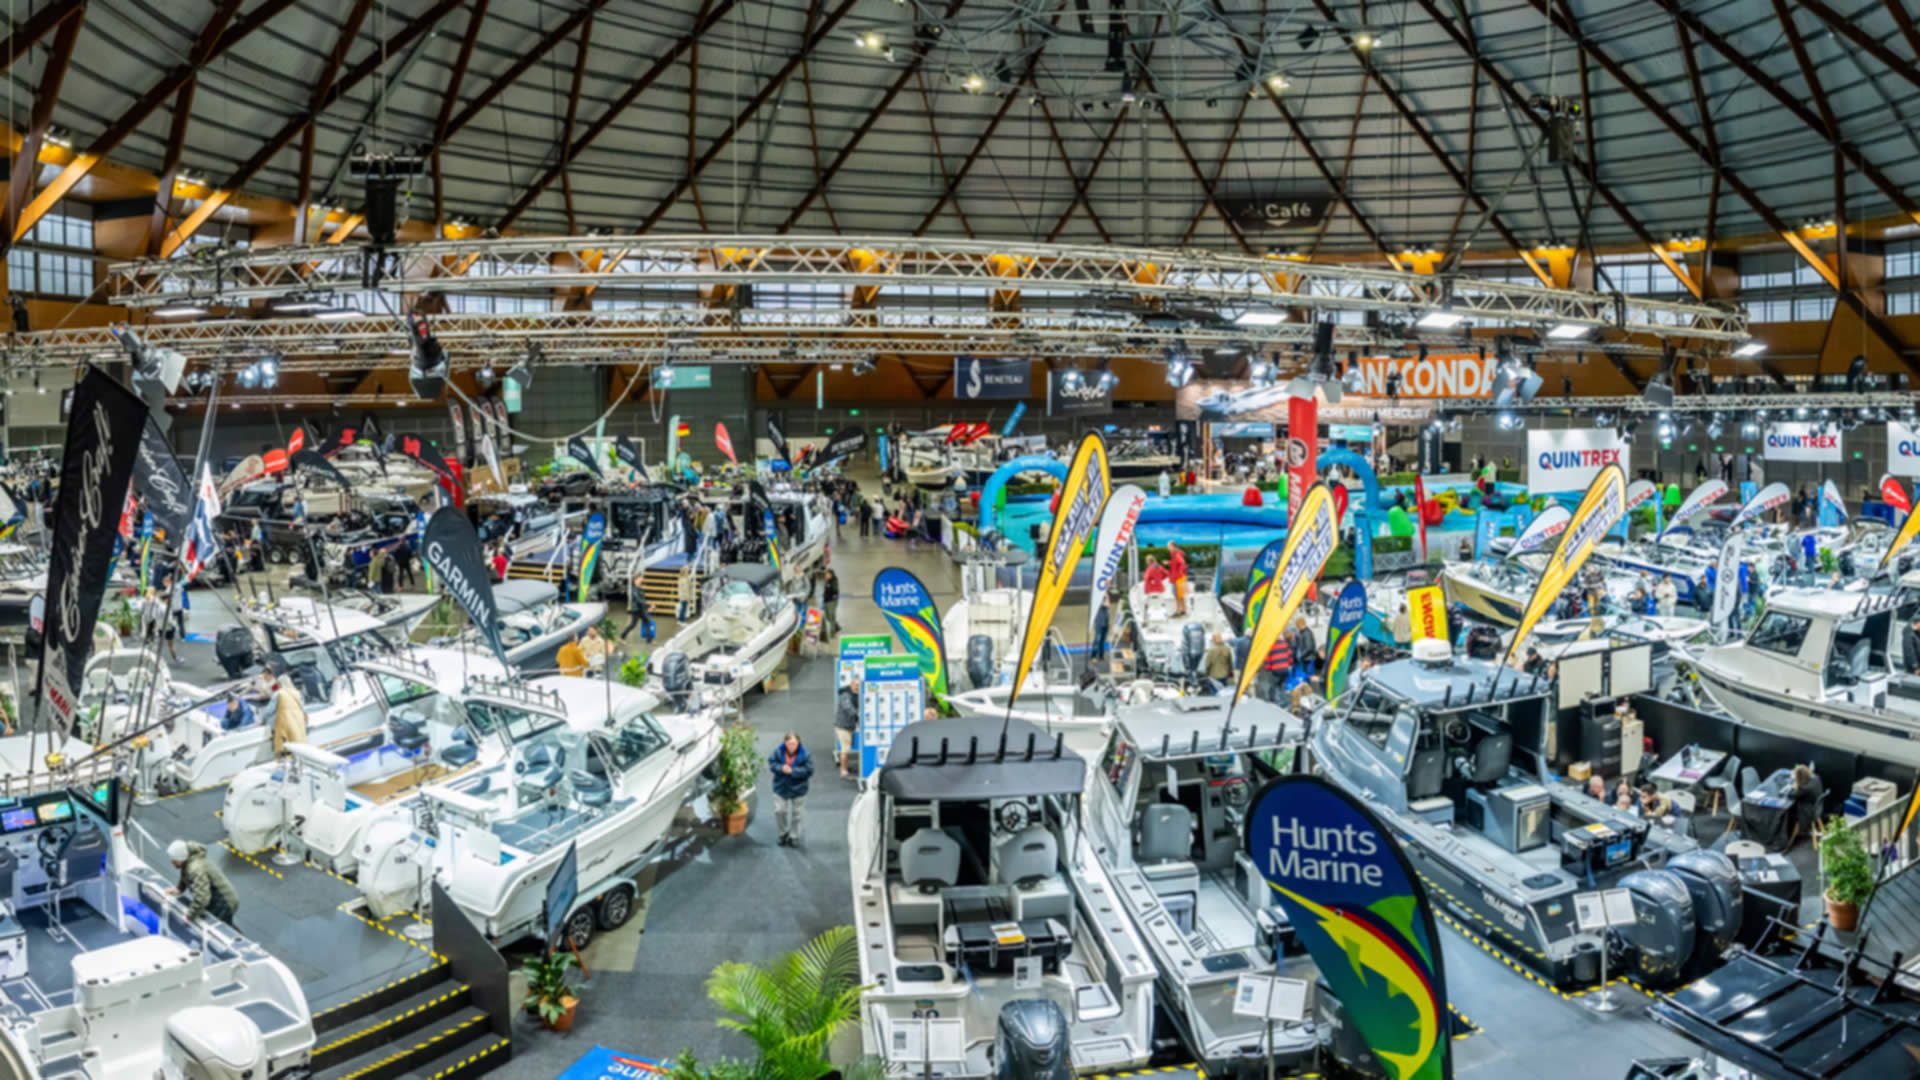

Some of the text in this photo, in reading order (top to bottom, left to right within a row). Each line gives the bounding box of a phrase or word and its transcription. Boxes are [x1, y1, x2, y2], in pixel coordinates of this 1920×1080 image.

[1265, 202, 1311, 218] Café
[984, 374, 1024, 385] BENETEAU
[1767, 434, 1837, 449] QUINTREX
[1539, 448, 1621, 471] QUINTREX
[1096, 494, 1145, 592] QUINTREX
[427, 541, 491, 628] GARMIN
[881, 582, 917, 594] Hunts
[881, 595, 919, 607] Marine
[1271, 815, 1378, 856] Hunts
[1269, 847, 1383, 887] Marine
